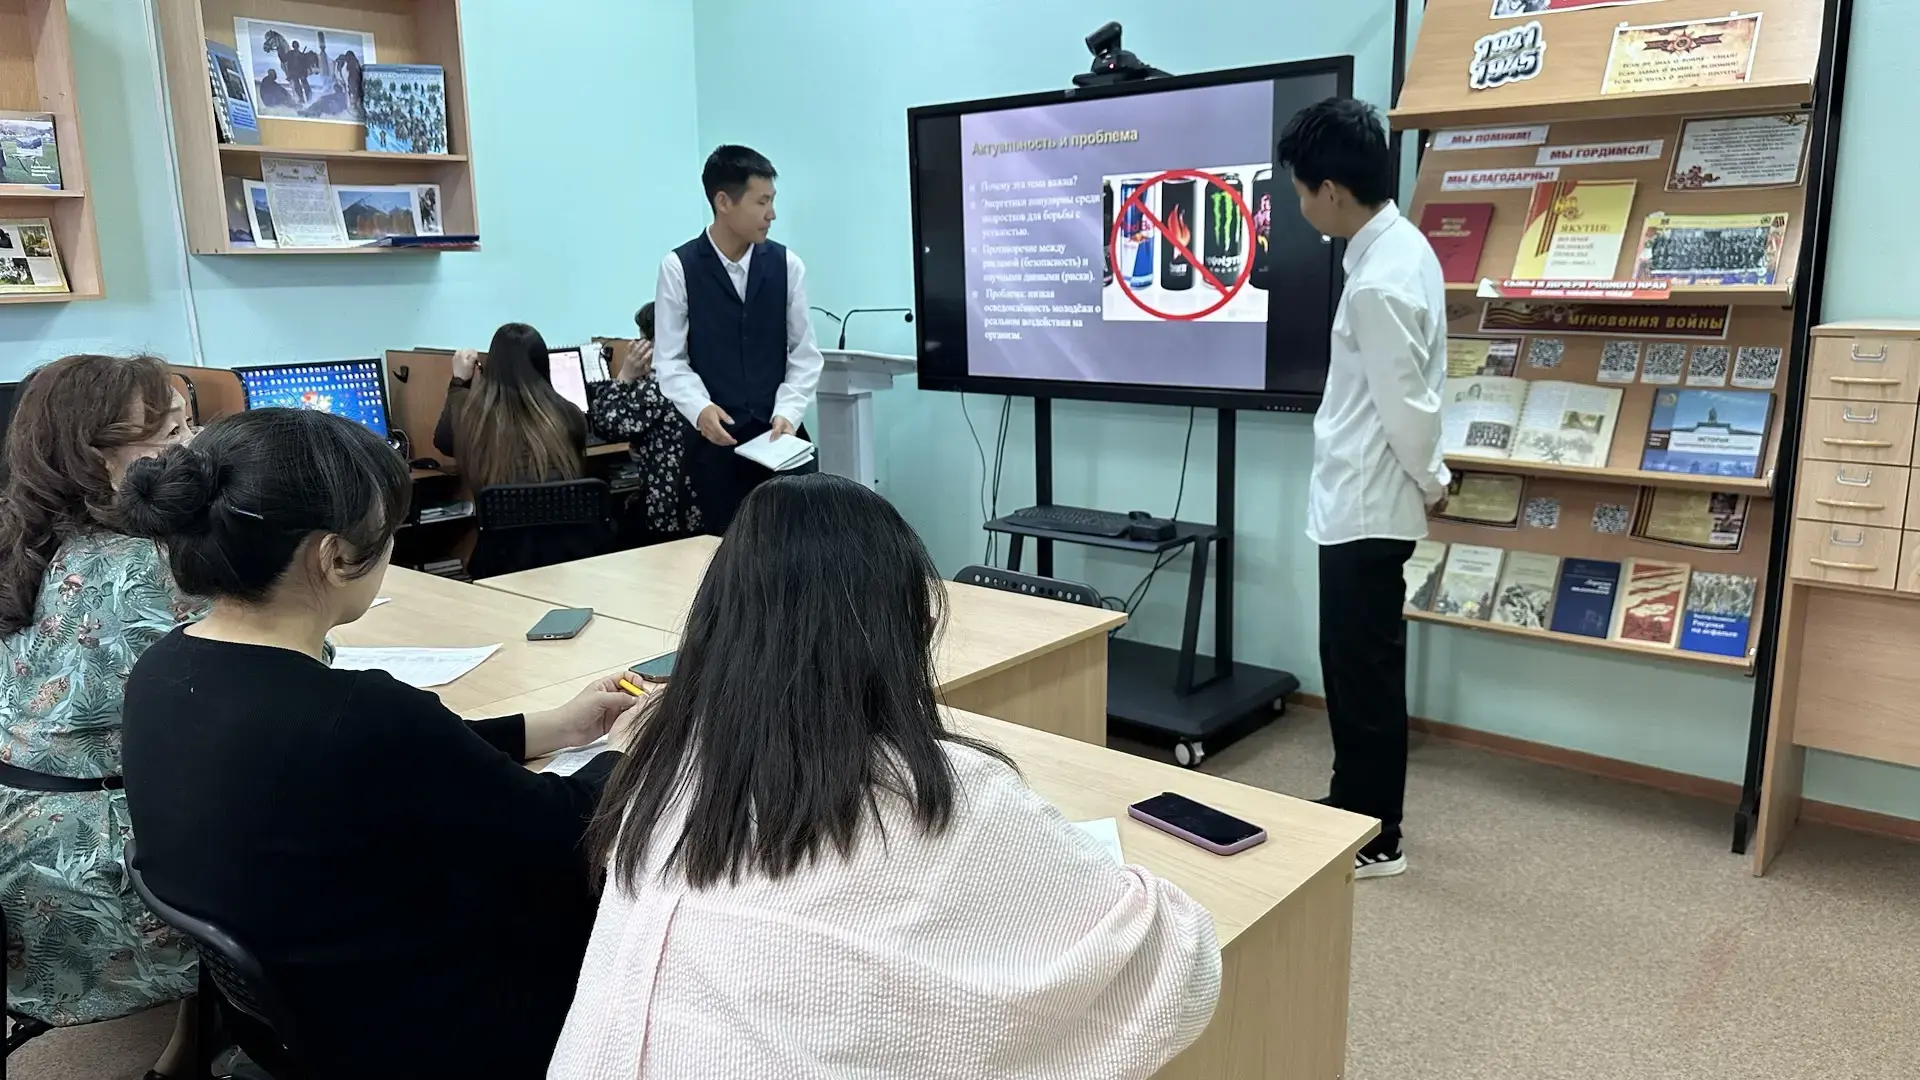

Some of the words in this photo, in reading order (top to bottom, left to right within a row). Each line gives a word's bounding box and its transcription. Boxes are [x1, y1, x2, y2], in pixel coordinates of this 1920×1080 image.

[1478, 26, 1542, 61] 1941
[1473, 49, 1539, 84] 1945
[972, 137, 1056, 158] Актуальность
[1059, 134, 1069, 148] и
[1071, 129, 1139, 149] проблема
[1451, 134, 1472, 144] МЫ
[1475, 130, 1532, 142] ПОМНИМ!
[1550, 149, 1573, 160] МЫ
[1576, 144, 1650, 158] ГОРДИМСЯ!
[981, 181, 1012, 192] Почему
[1027, 179, 1046, 189] тема
[1048, 175, 1078, 188] важна?
[1447, 173, 1468, 184] МЫ
[1470, 171, 1554, 183] БЛАГОДАРНЫ!
[1029, 195, 1075, 208] популярны
[1075, 193, 1101, 207] среди
[981, 211, 1026, 226] подростков
[1027, 211, 1042, 223] для
[1043, 207, 1074, 223] борьбы
[1560, 223, 1610, 233] ЯКУТИЯ:
[982, 244, 1037, 256] Противоречие
[1039, 244, 1067, 256] между
[1020, 256, 1082, 269] (безопасность)
[983, 273, 1022, 284] научными
[1023, 273, 1060, 283] данными
[1061, 270, 1096, 284] (риски).
[1637, 281, 1668, 290] КРАЯ
[1028, 290, 1055, 299] низкая
[1073, 319, 1084, 328] на
[1567, 311, 1659, 328] мгновения
[1665, 314, 1723, 330] войны
